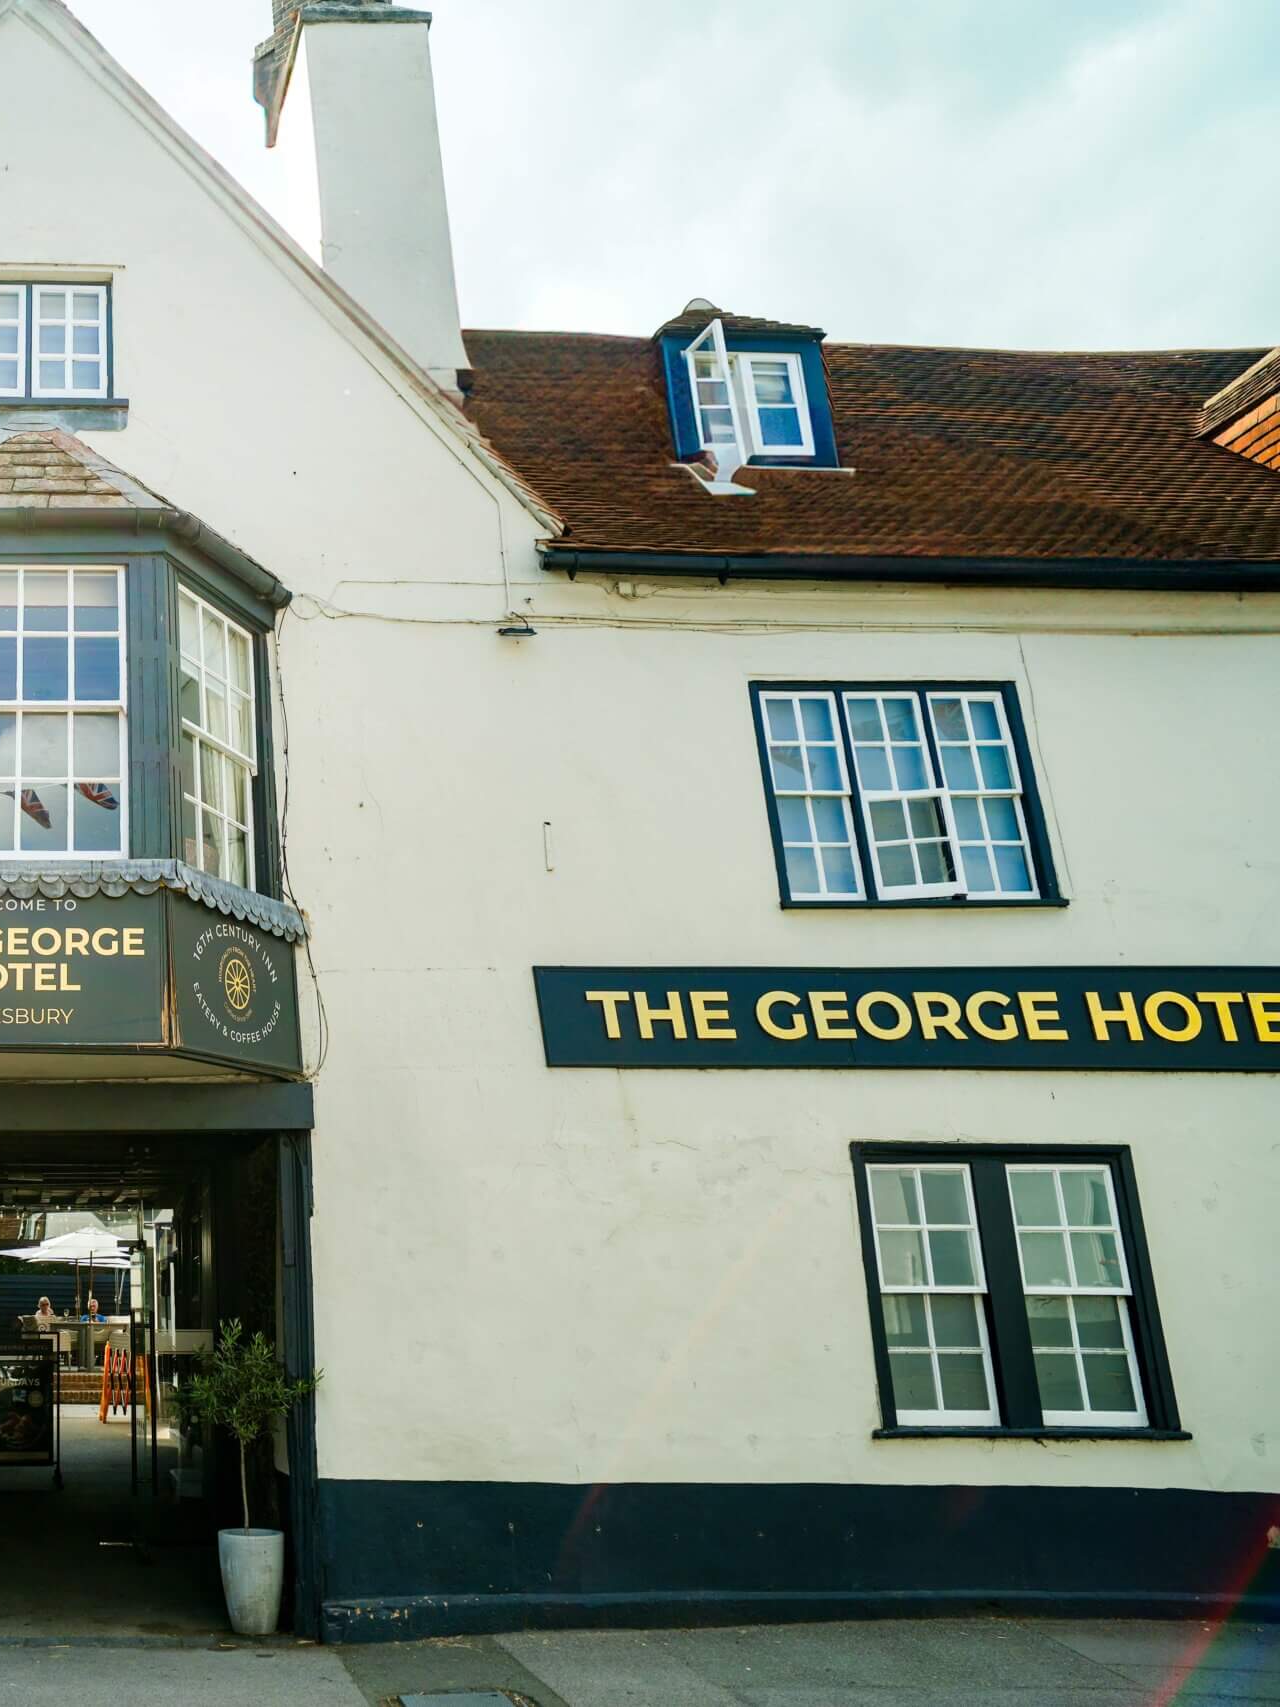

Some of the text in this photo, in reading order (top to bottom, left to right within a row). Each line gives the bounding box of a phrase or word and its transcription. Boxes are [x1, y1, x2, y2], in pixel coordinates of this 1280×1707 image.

[54, 899, 77, 911] TO
[192, 928, 214, 961] 16TH
[215, 923, 261, 953] CENTURY
[261, 951, 278, 983] INN
[193, 981, 221, 1029] EATERY
[222, 1025, 228, 1037] &
[230, 1030, 261, 1044] COFFEE
[262, 1000, 281, 1038] HOUSE
[585, 990, 1280, 1043] THE GEORGE HOTE
